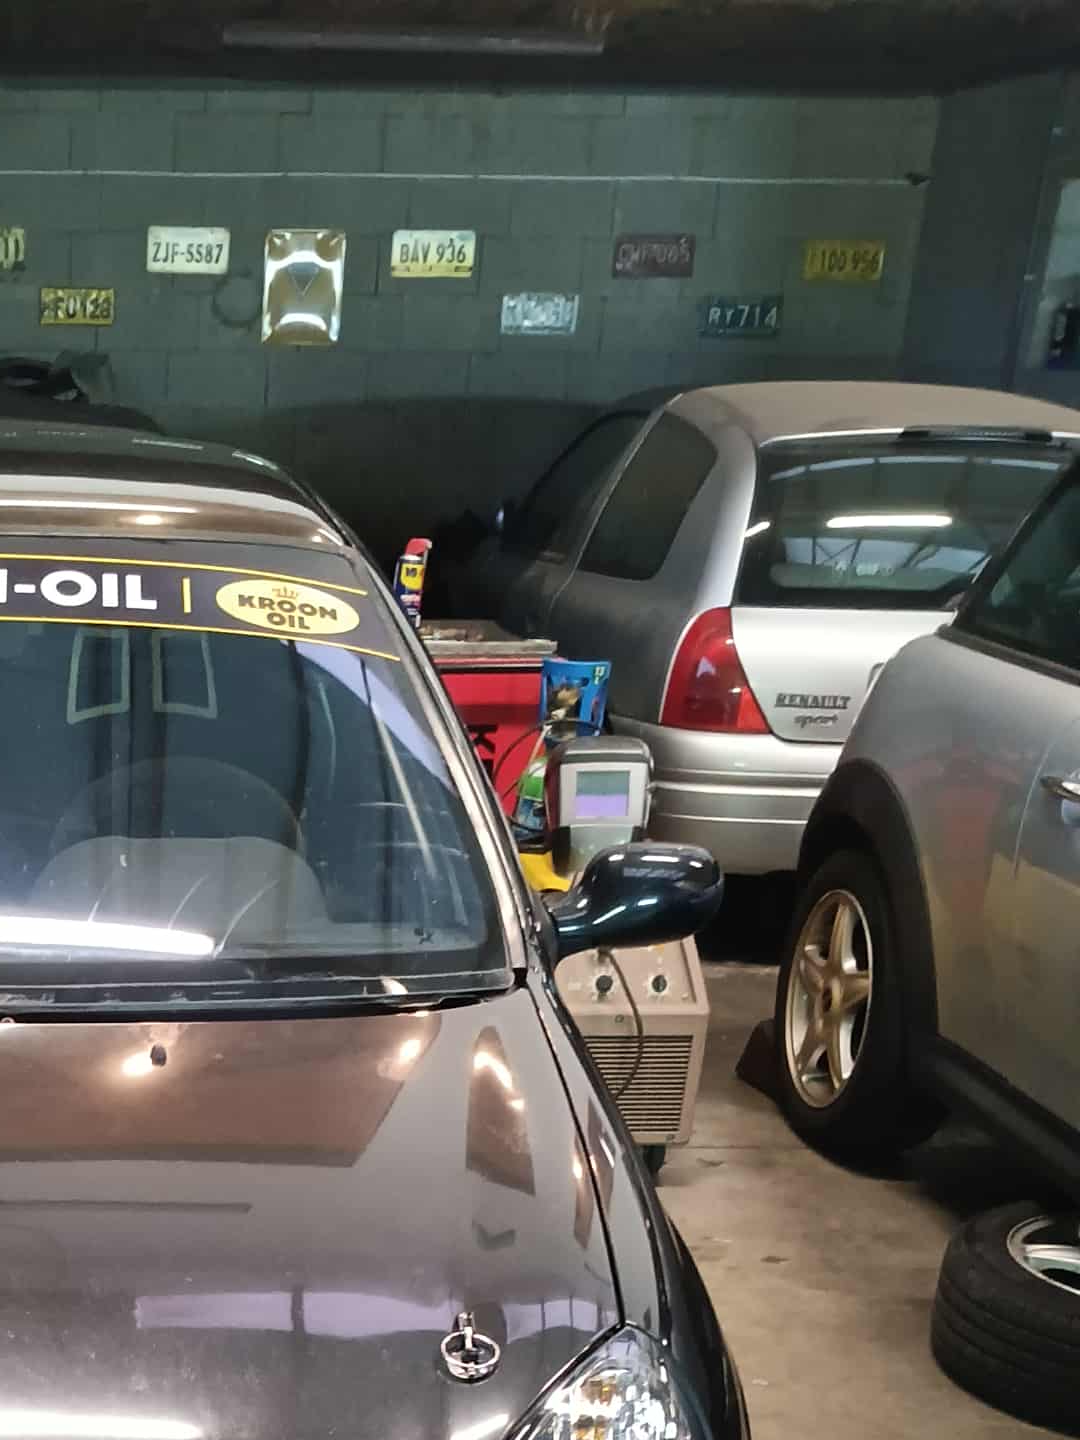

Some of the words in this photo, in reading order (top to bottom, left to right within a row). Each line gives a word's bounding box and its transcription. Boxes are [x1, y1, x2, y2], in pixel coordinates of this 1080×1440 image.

[237, 593, 338, 621] KROON
[266, 612, 311, 631] OIL
[774, 693, 851, 710] RENAULT
